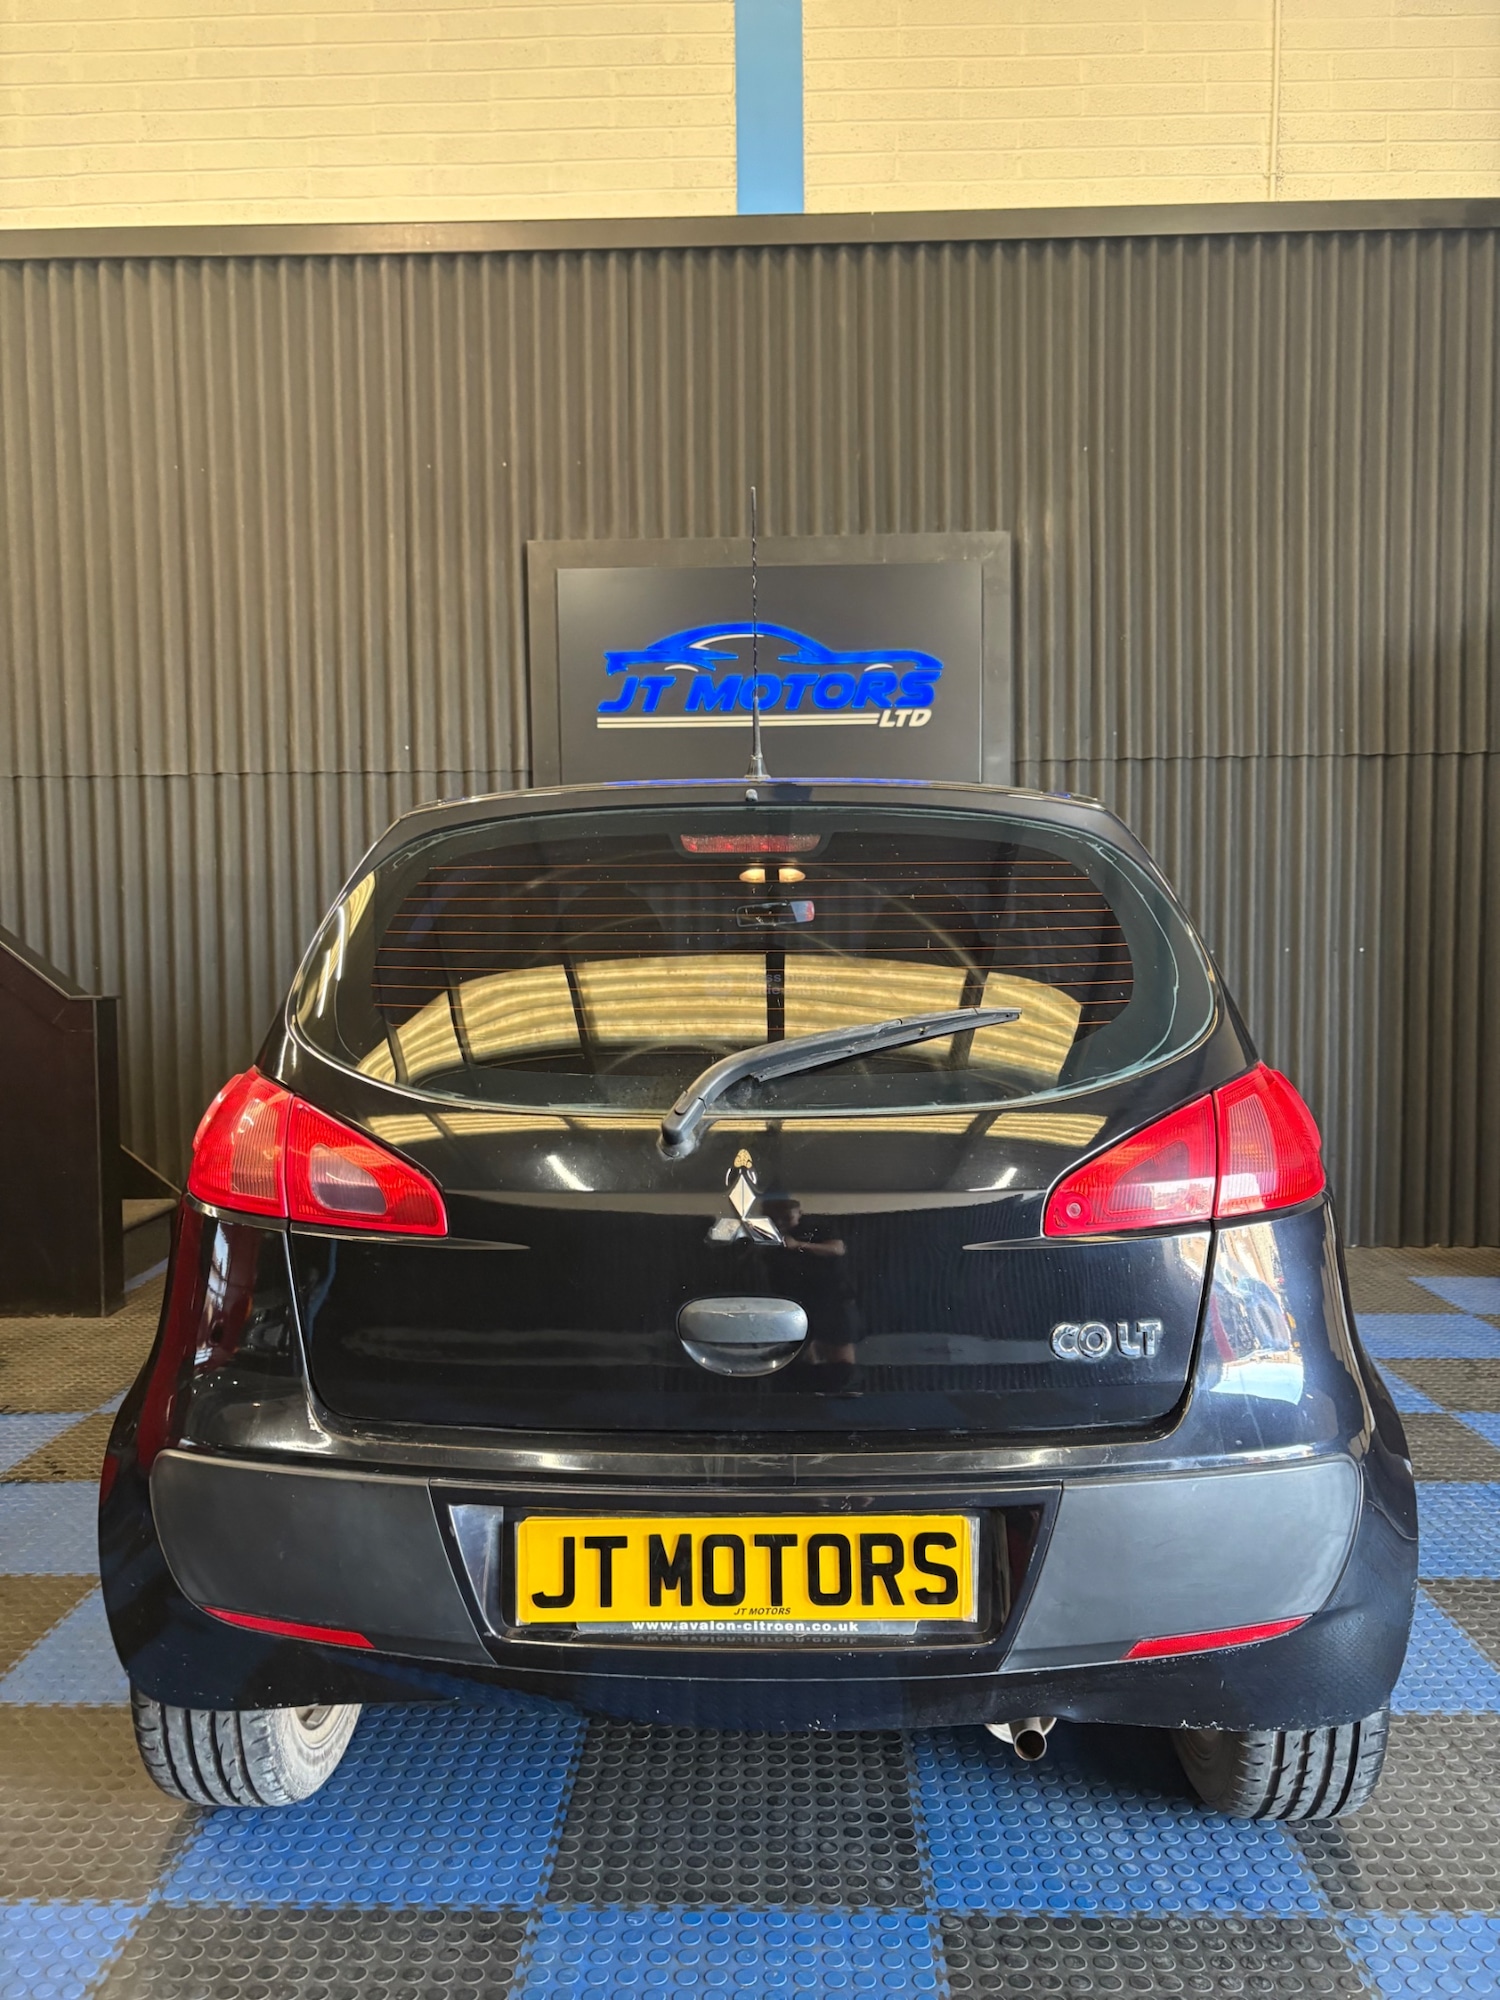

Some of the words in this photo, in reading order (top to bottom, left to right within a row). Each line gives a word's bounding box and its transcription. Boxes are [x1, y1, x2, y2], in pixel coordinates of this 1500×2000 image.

[598, 676, 676, 713] JT
[684, 672, 942, 712] MOTORS
[879, 708, 932, 728] LTD
[1050, 1321, 1162, 1359] COLT
[531, 1536, 628, 1608] JT
[649, 1532, 958, 1607] MOTORS
[749, 1607, 791, 1615] MOTORS
[632, 1620, 859, 1632] www.avalon-citroen.co.uk
